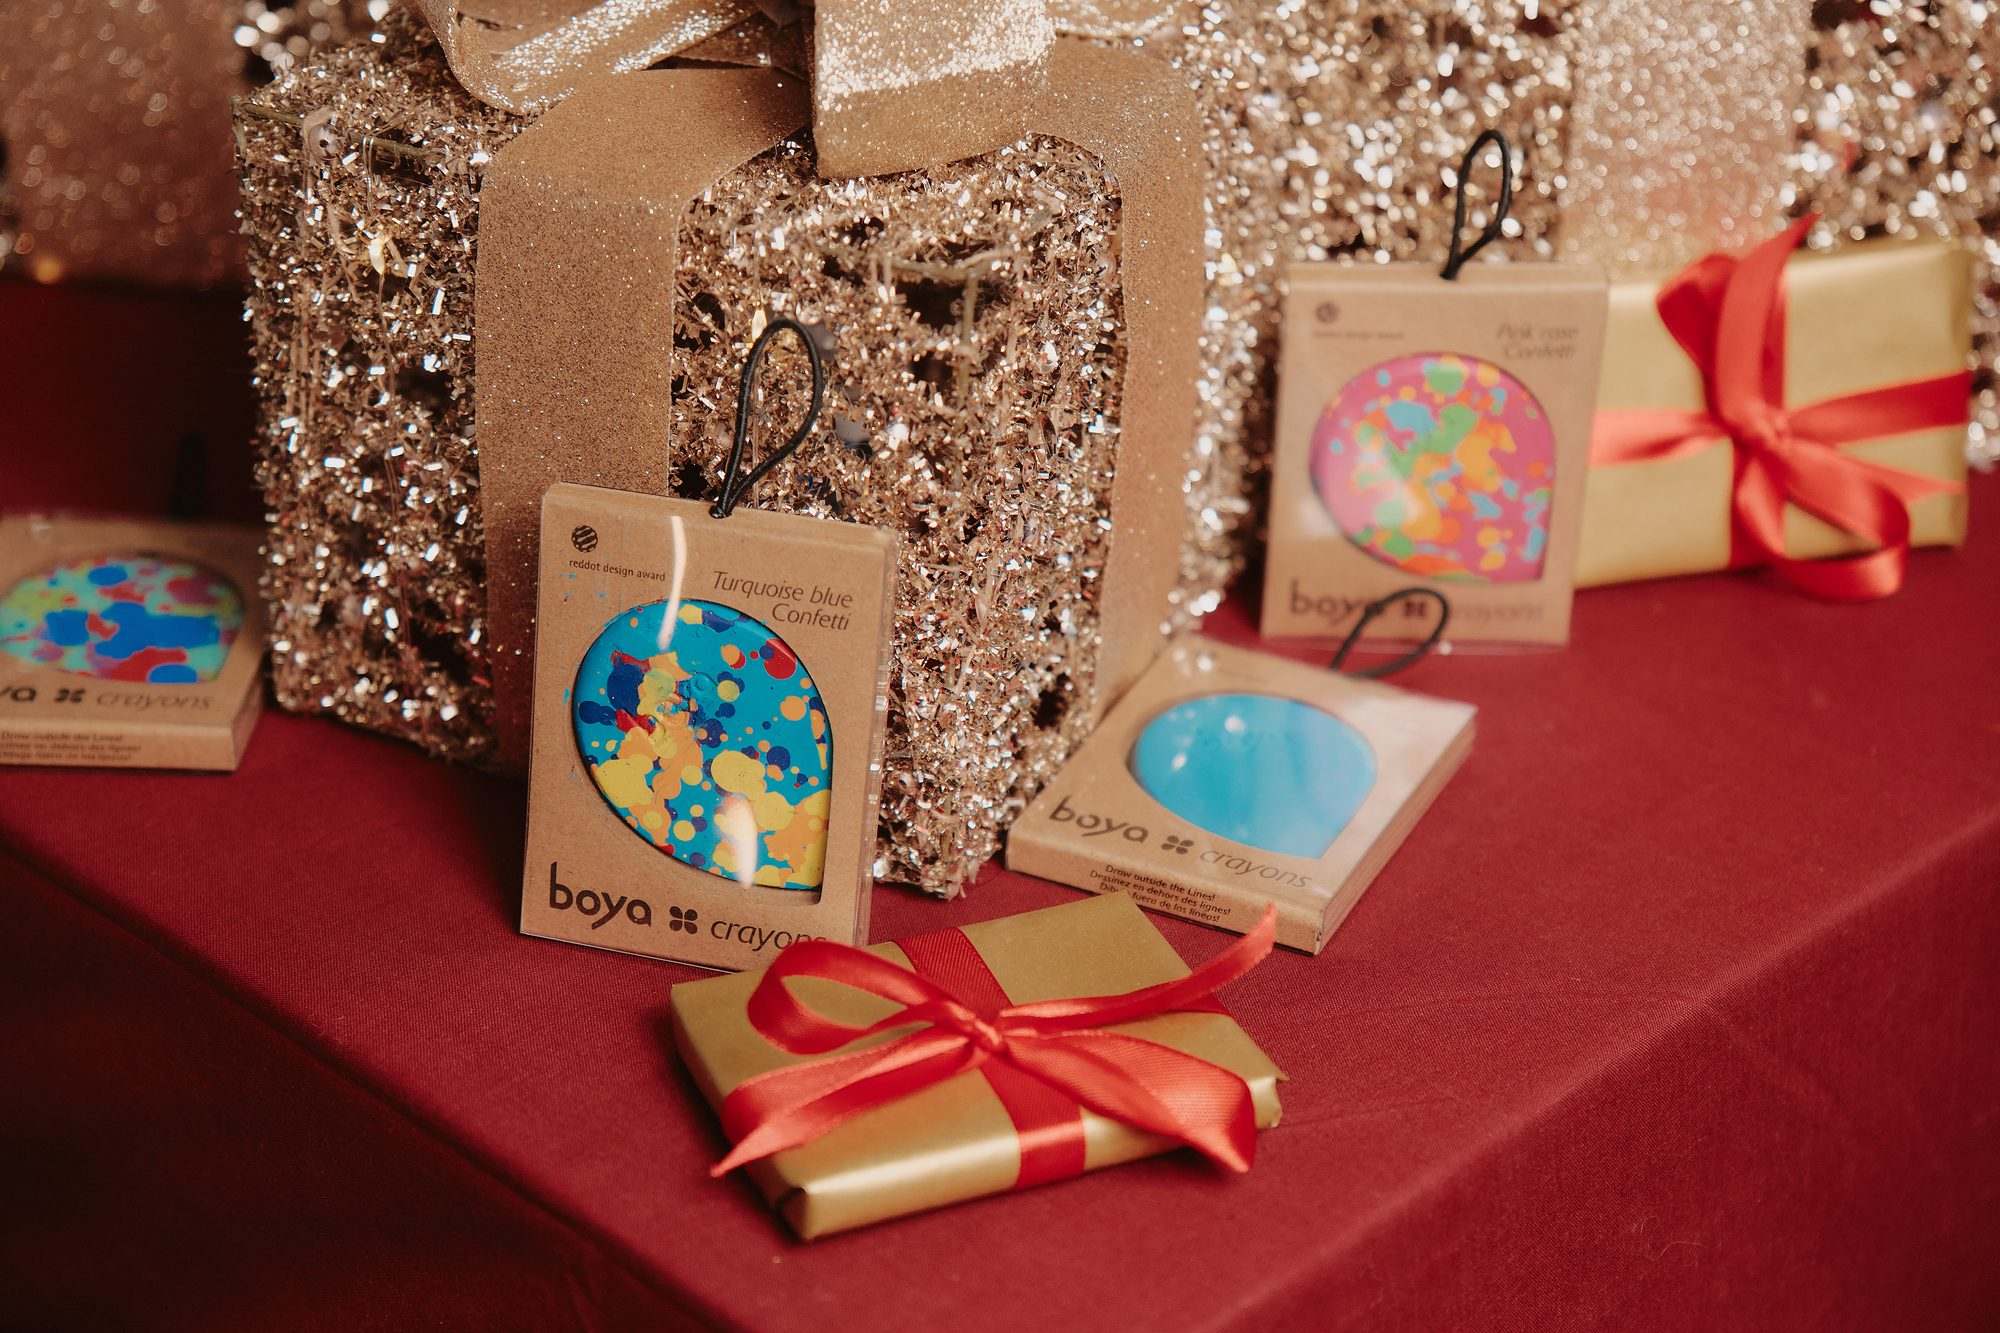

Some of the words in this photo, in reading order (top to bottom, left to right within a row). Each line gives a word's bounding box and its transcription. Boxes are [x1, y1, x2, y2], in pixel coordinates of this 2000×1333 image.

[569, 558, 601, 573] reddot
[602, 563, 634, 578] design
[636, 569, 666, 582] award
[712, 571, 804, 600] Turquoise
[809, 583, 853, 608] blue
[772, 602, 852, 631] Confetti
[1049, 795, 1149, 843] boya
[1200, 848, 1312, 888] crayons
[1089, 869, 1130, 887] Dessinez
[1132, 883, 1145, 892] en
[1146, 885, 1180, 901] dehors
[1181, 896, 1198, 907] des
[1105, 864, 1132, 877] Draw
[1134, 874, 1168, 888] outside
[1169, 882, 1186, 894] the
[1187, 887, 1216, 901] Lines!
[549, 861, 652, 930] boya
[710, 919, 826, 951] crayon
[1159, 900, 1171, 910] de
